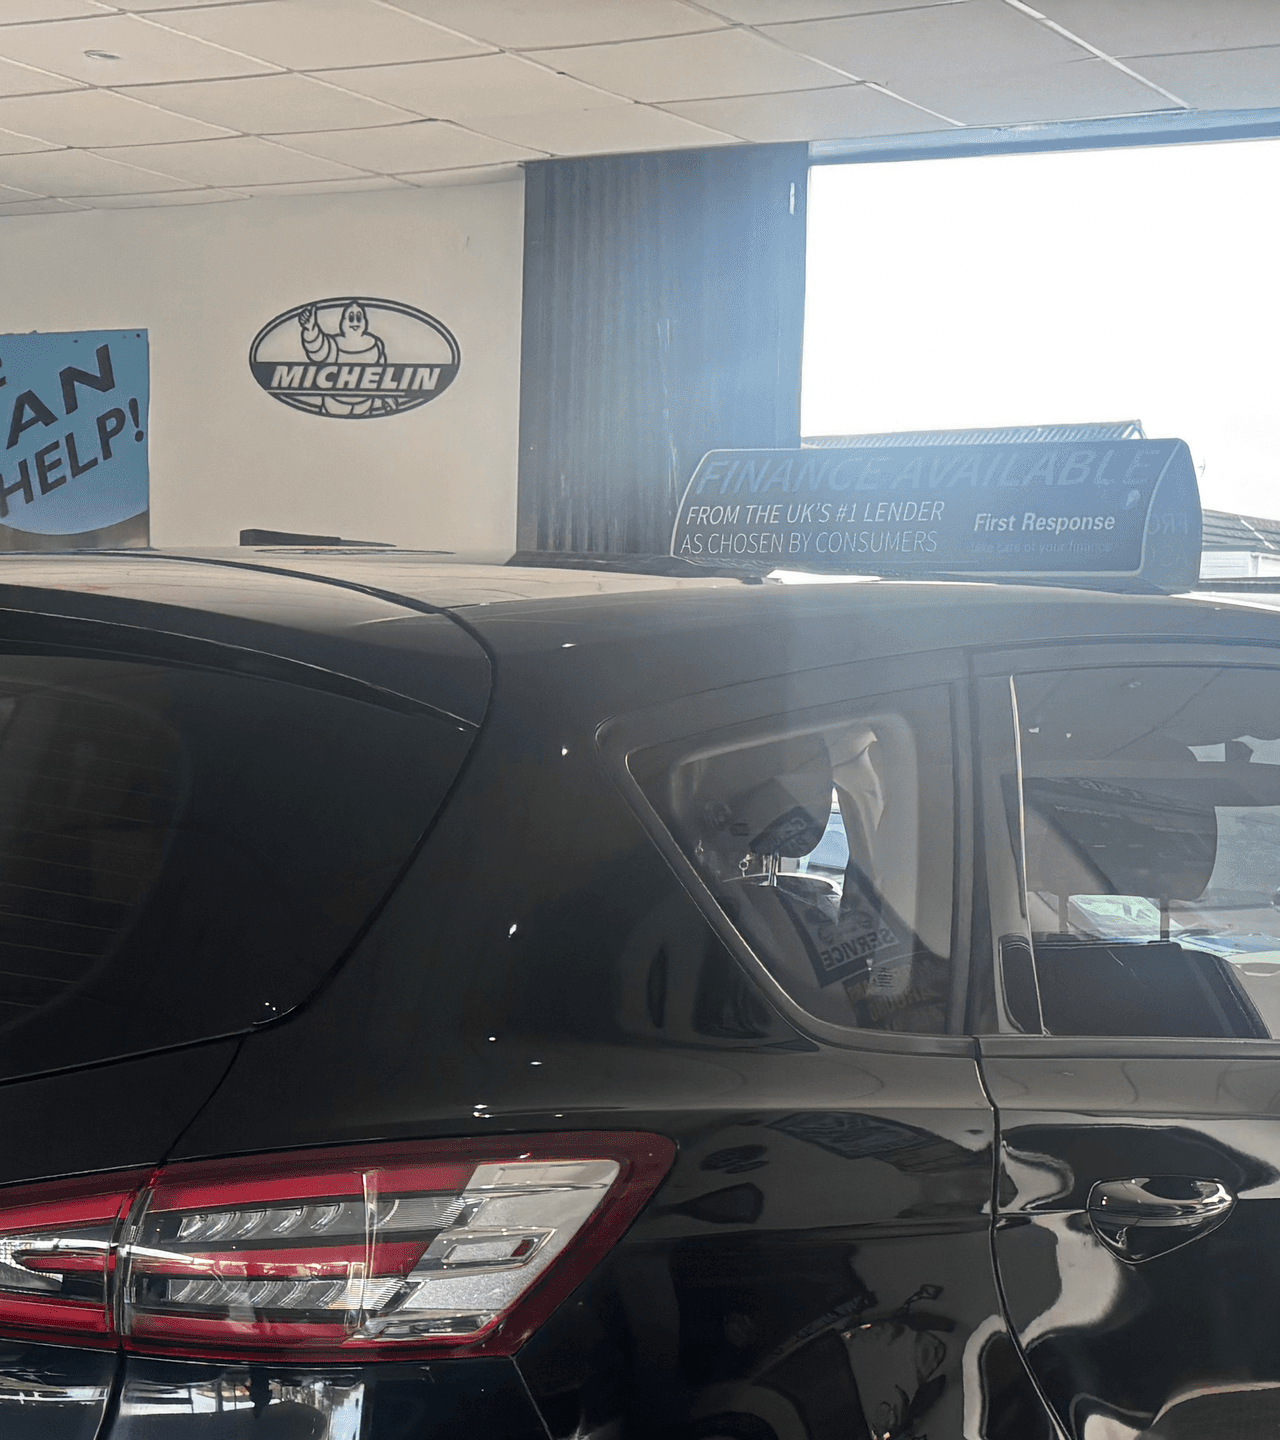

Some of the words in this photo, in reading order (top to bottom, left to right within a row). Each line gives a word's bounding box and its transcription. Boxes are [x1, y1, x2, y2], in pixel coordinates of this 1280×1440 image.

[271, 366, 441, 390] MICHELIN
[696, 455, 892, 495] FINANCE
[890, 447, 1161, 491] AVAILABLE
[686, 504, 740, 526] FROM
[746, 504, 783, 525] THE
[836, 502, 857, 523] #1
[863, 501, 945, 523] LENDER
[974, 513, 1016, 531] First
[1021, 512, 1115, 535] Response
[680, 534, 703, 554] AS
[708, 533, 784, 554] CHOSEN
[789, 532, 811, 552] BY
[816, 531, 938, 553] CONSUMERS
